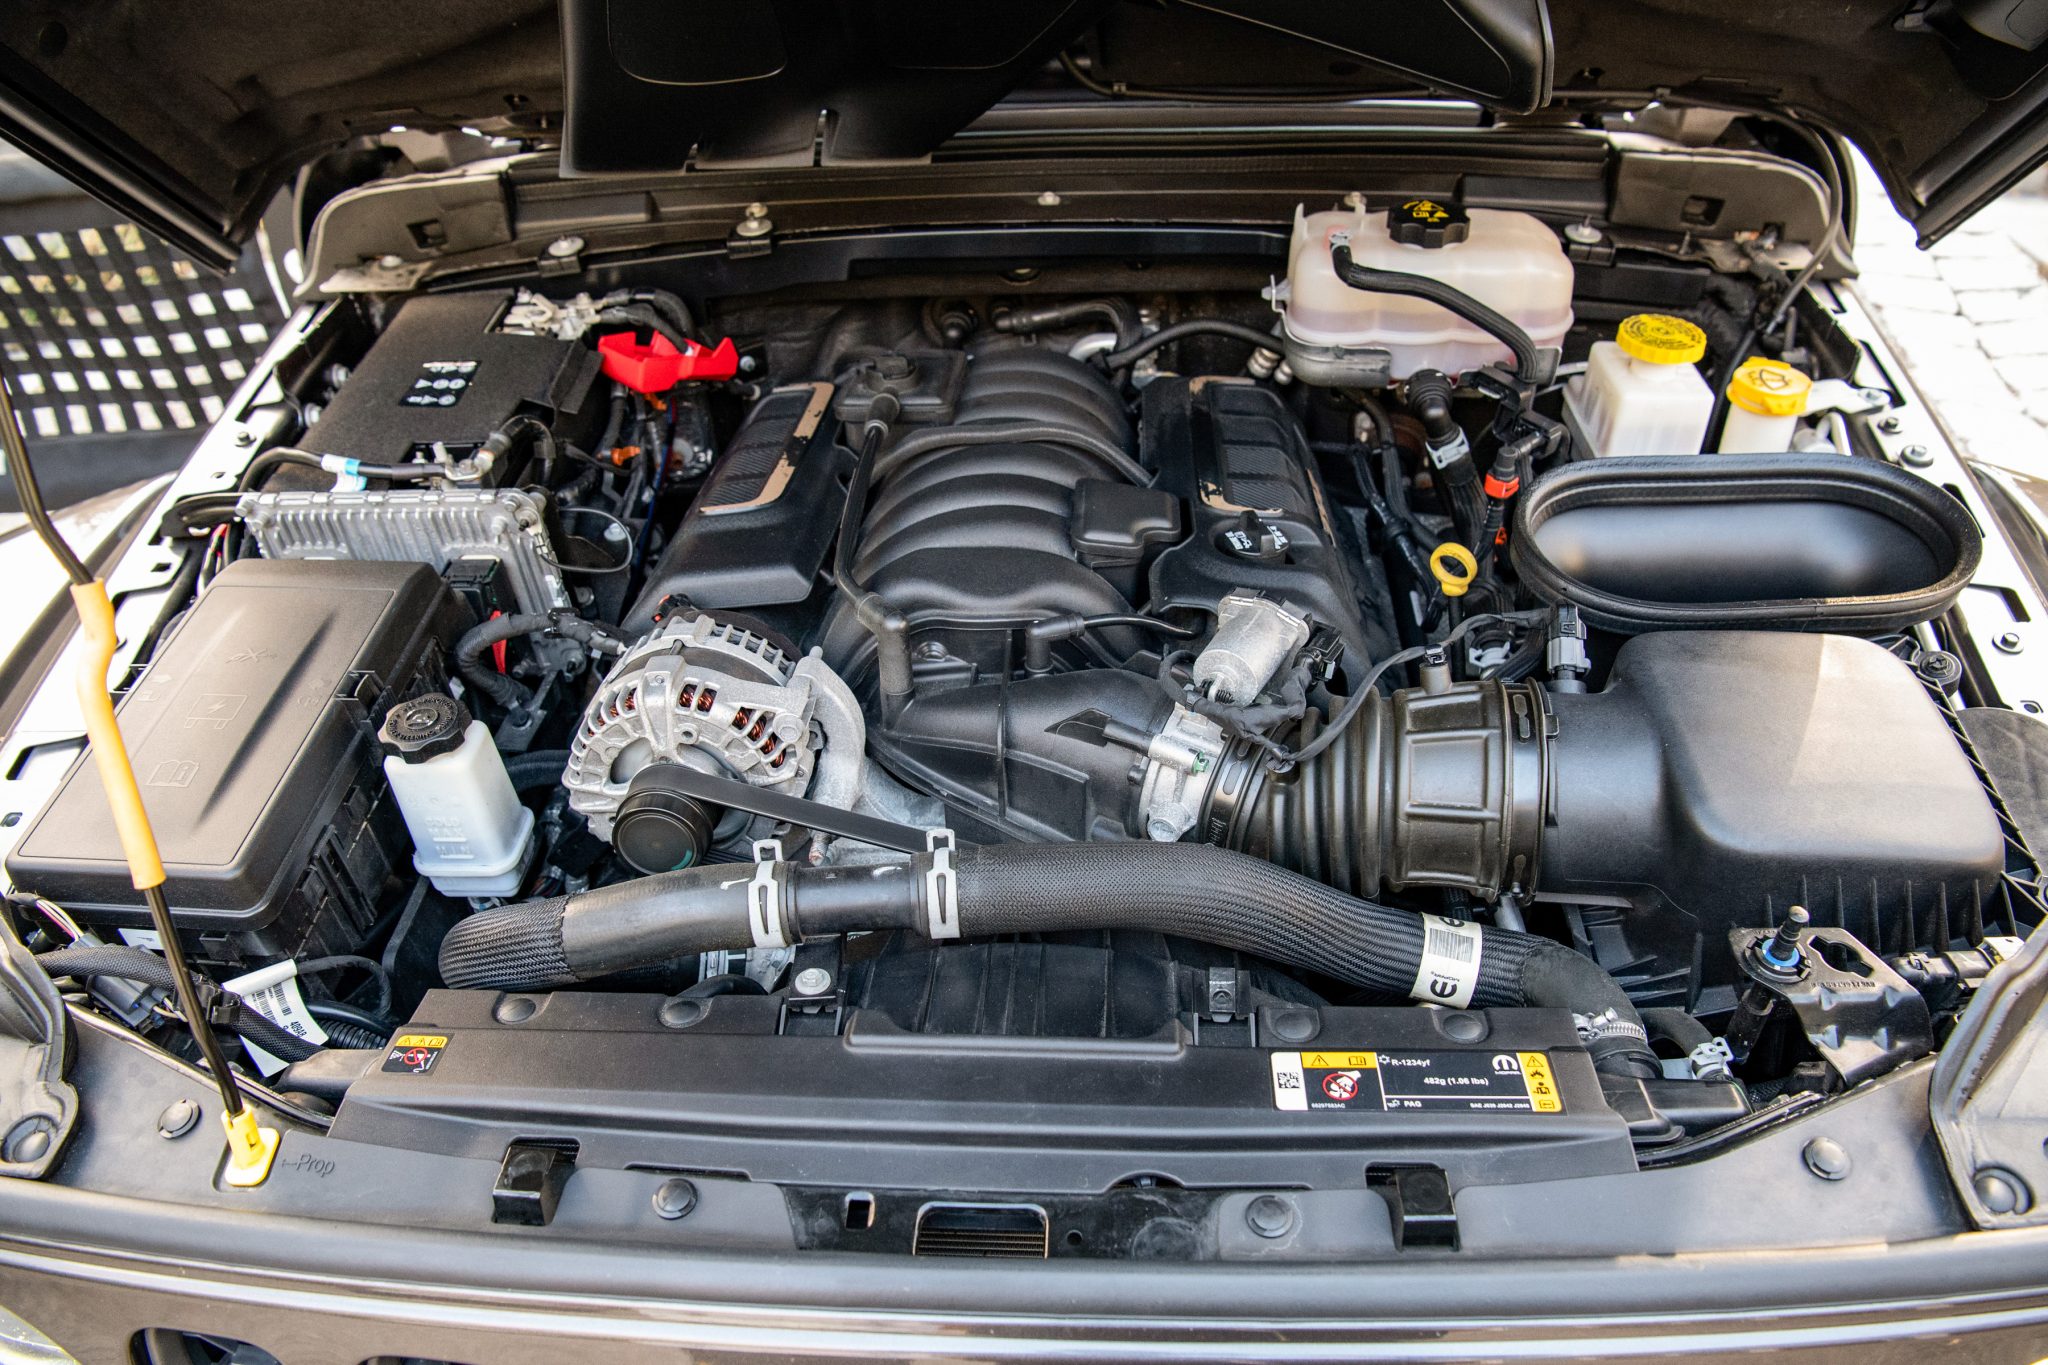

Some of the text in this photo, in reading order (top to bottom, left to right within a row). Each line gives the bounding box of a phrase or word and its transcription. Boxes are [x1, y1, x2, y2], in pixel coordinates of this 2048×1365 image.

[1391, 1059, 1431, 1067] R-1234yf
[1471, 1077, 1489, 1086] lbs)
[296, 1153, 335, 1178] Prop
